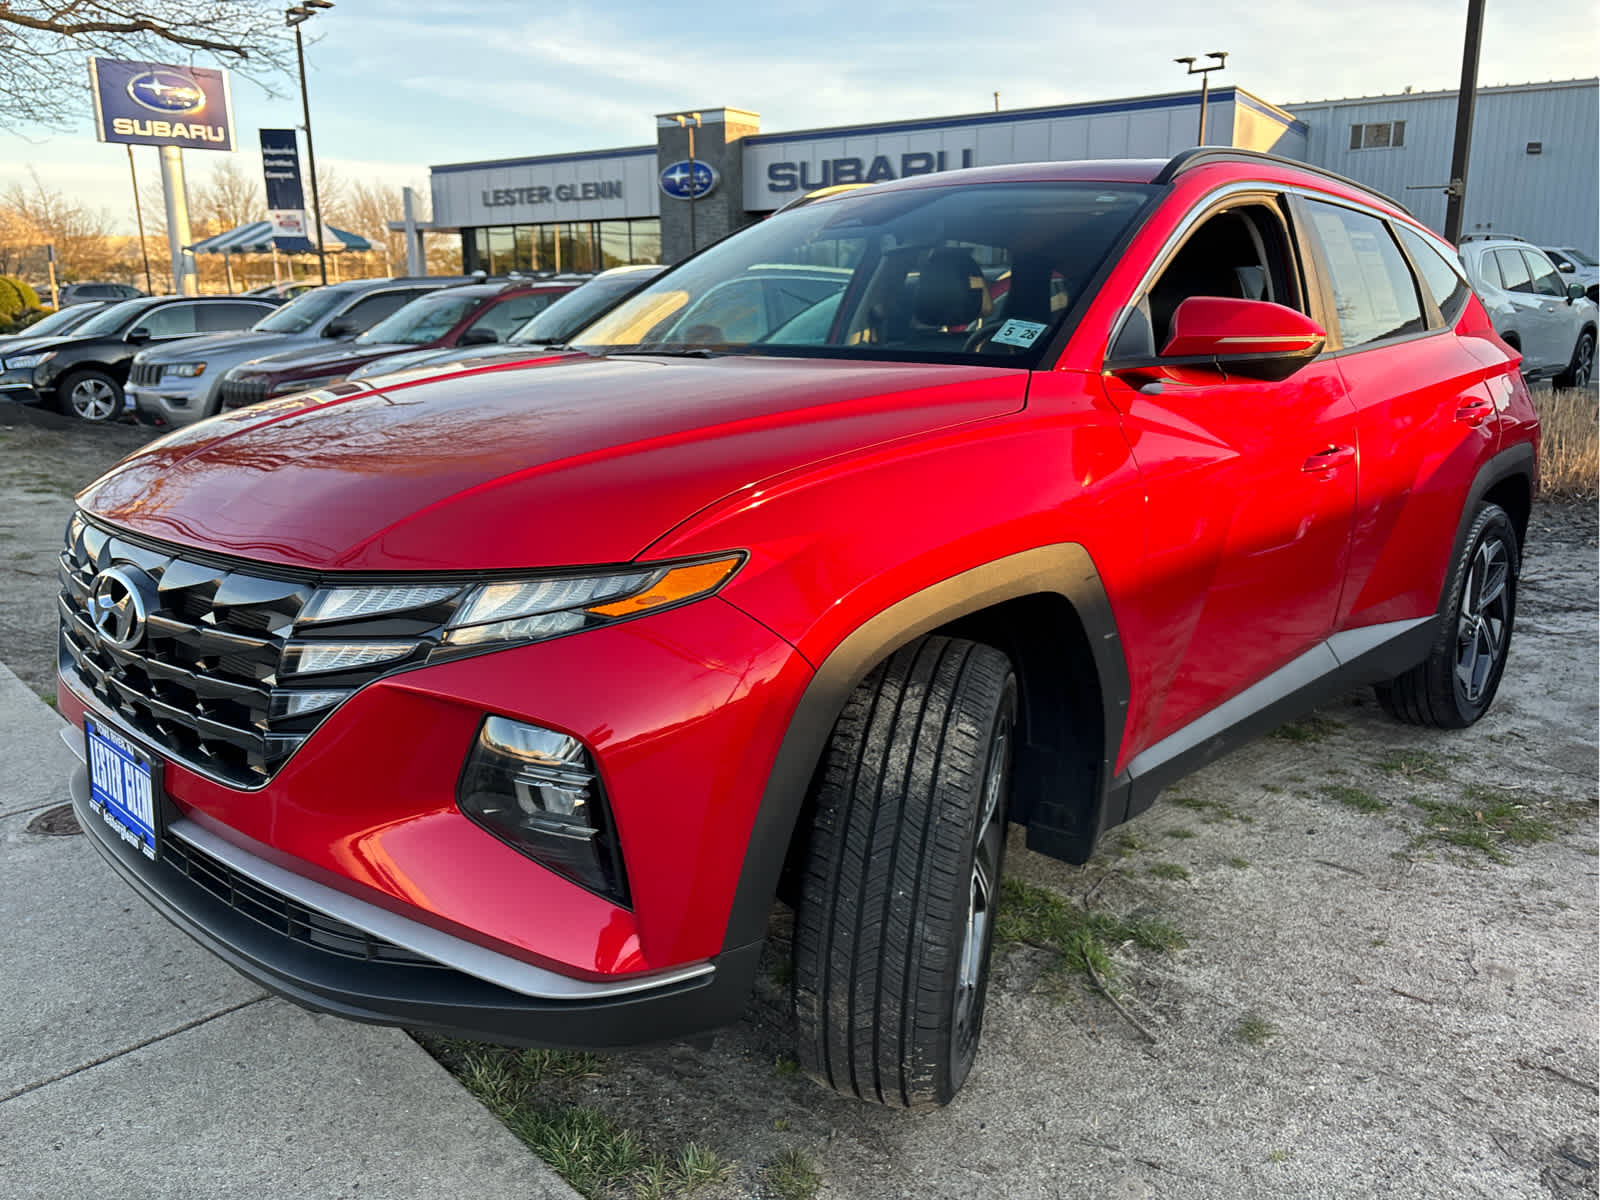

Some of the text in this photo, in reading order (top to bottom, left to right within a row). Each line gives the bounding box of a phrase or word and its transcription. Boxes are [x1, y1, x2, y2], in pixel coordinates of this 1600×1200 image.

[112, 118, 225, 142] SUBARU
[768, 149, 972, 193] SUBARU
[481, 180, 622, 208] LESTER GLENN
[1003, 327, 1038, 340] 5 28
[89, 736, 155, 831] LESTER GLENN
